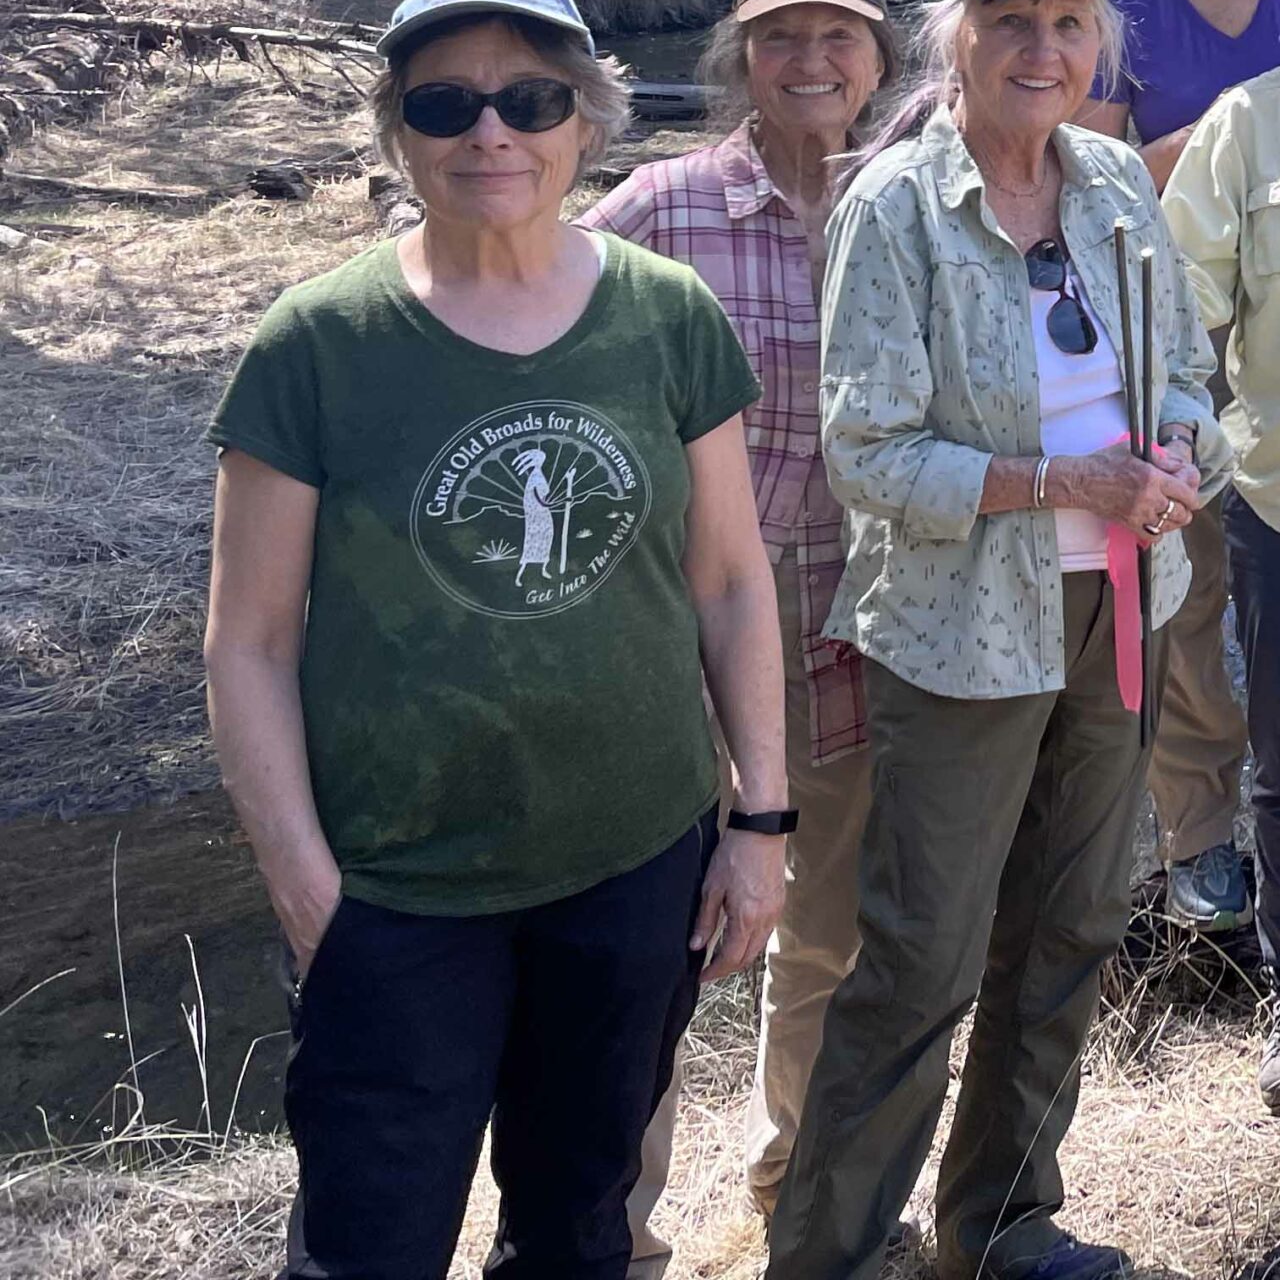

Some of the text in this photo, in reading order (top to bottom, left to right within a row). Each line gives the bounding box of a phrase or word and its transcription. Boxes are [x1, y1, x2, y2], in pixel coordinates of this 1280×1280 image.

[426, 411, 637, 517] Great Old Broads for Wilderness
[526, 511, 636, 604] Get Into The Wild
